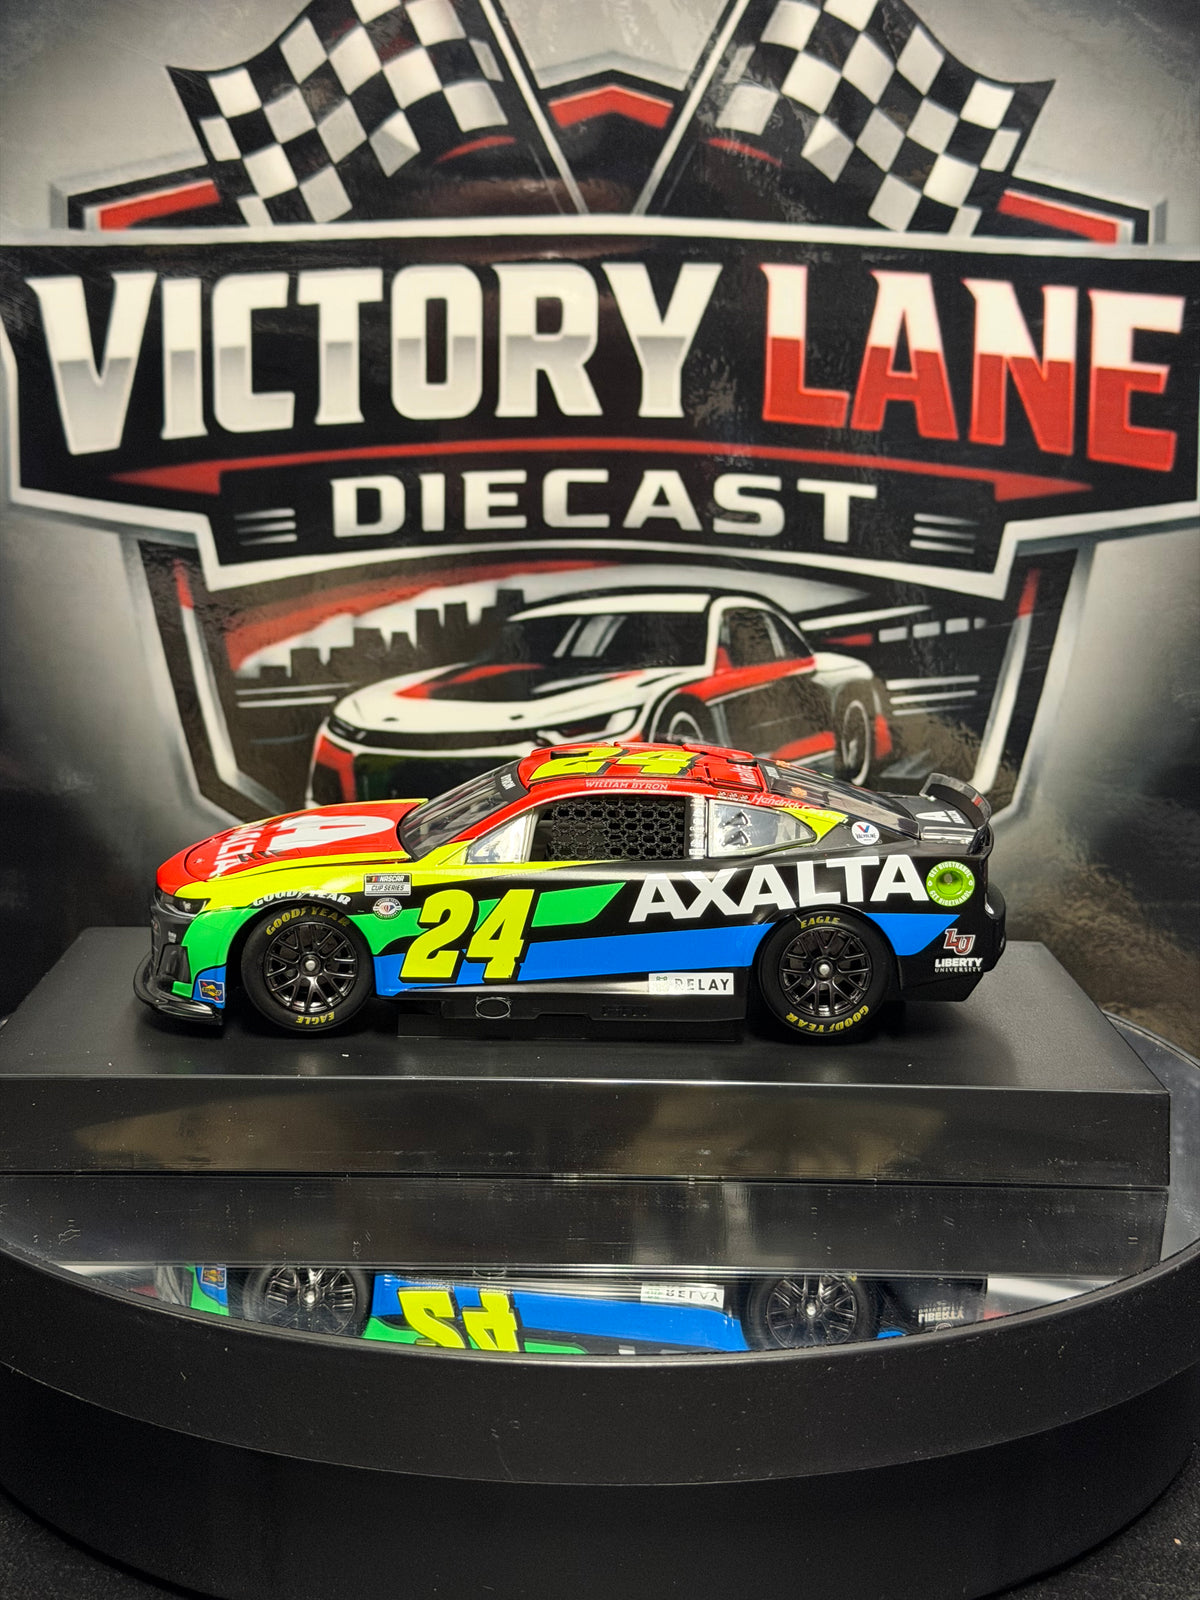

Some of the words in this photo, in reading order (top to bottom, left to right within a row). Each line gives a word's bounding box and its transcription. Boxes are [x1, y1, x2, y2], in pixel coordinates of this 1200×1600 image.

[25, 262, 723, 455] VICTORY
[759, 262, 1186, 472] LANE
[330, 469, 878, 543] DIECAST
[529, 747, 702, 781] 24
[585, 779, 629, 789] WILLIAM
[630, 781, 669, 790] BYRON
[629, 854, 930, 923] AXALTA
[400, 889, 535, 980] 24
[800, 915, 840, 929] EAGLE
[943, 928, 976, 956] LU
[935, 957, 983, 968] LIBERTY
[295, 1011, 335, 1025] EAGLE
